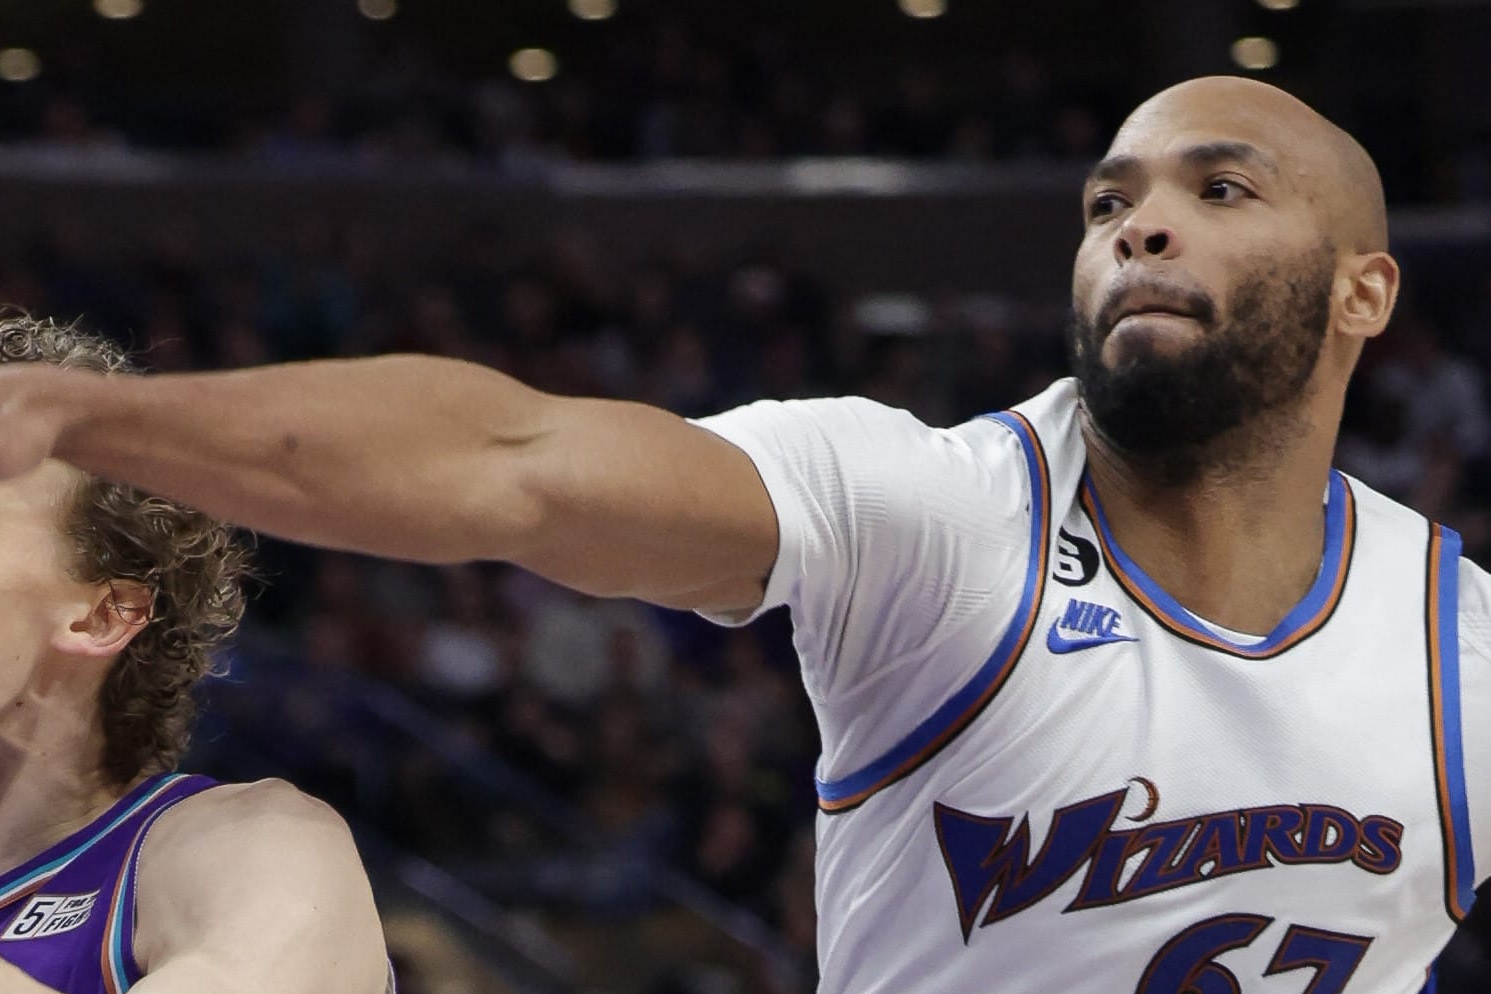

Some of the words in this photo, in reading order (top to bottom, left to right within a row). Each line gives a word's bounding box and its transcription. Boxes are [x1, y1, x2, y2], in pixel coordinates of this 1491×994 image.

[1060, 598, 1121, 637] NIKE
[934, 777, 1404, 945] WIZARDS
[13, 901, 56, 935] 5
